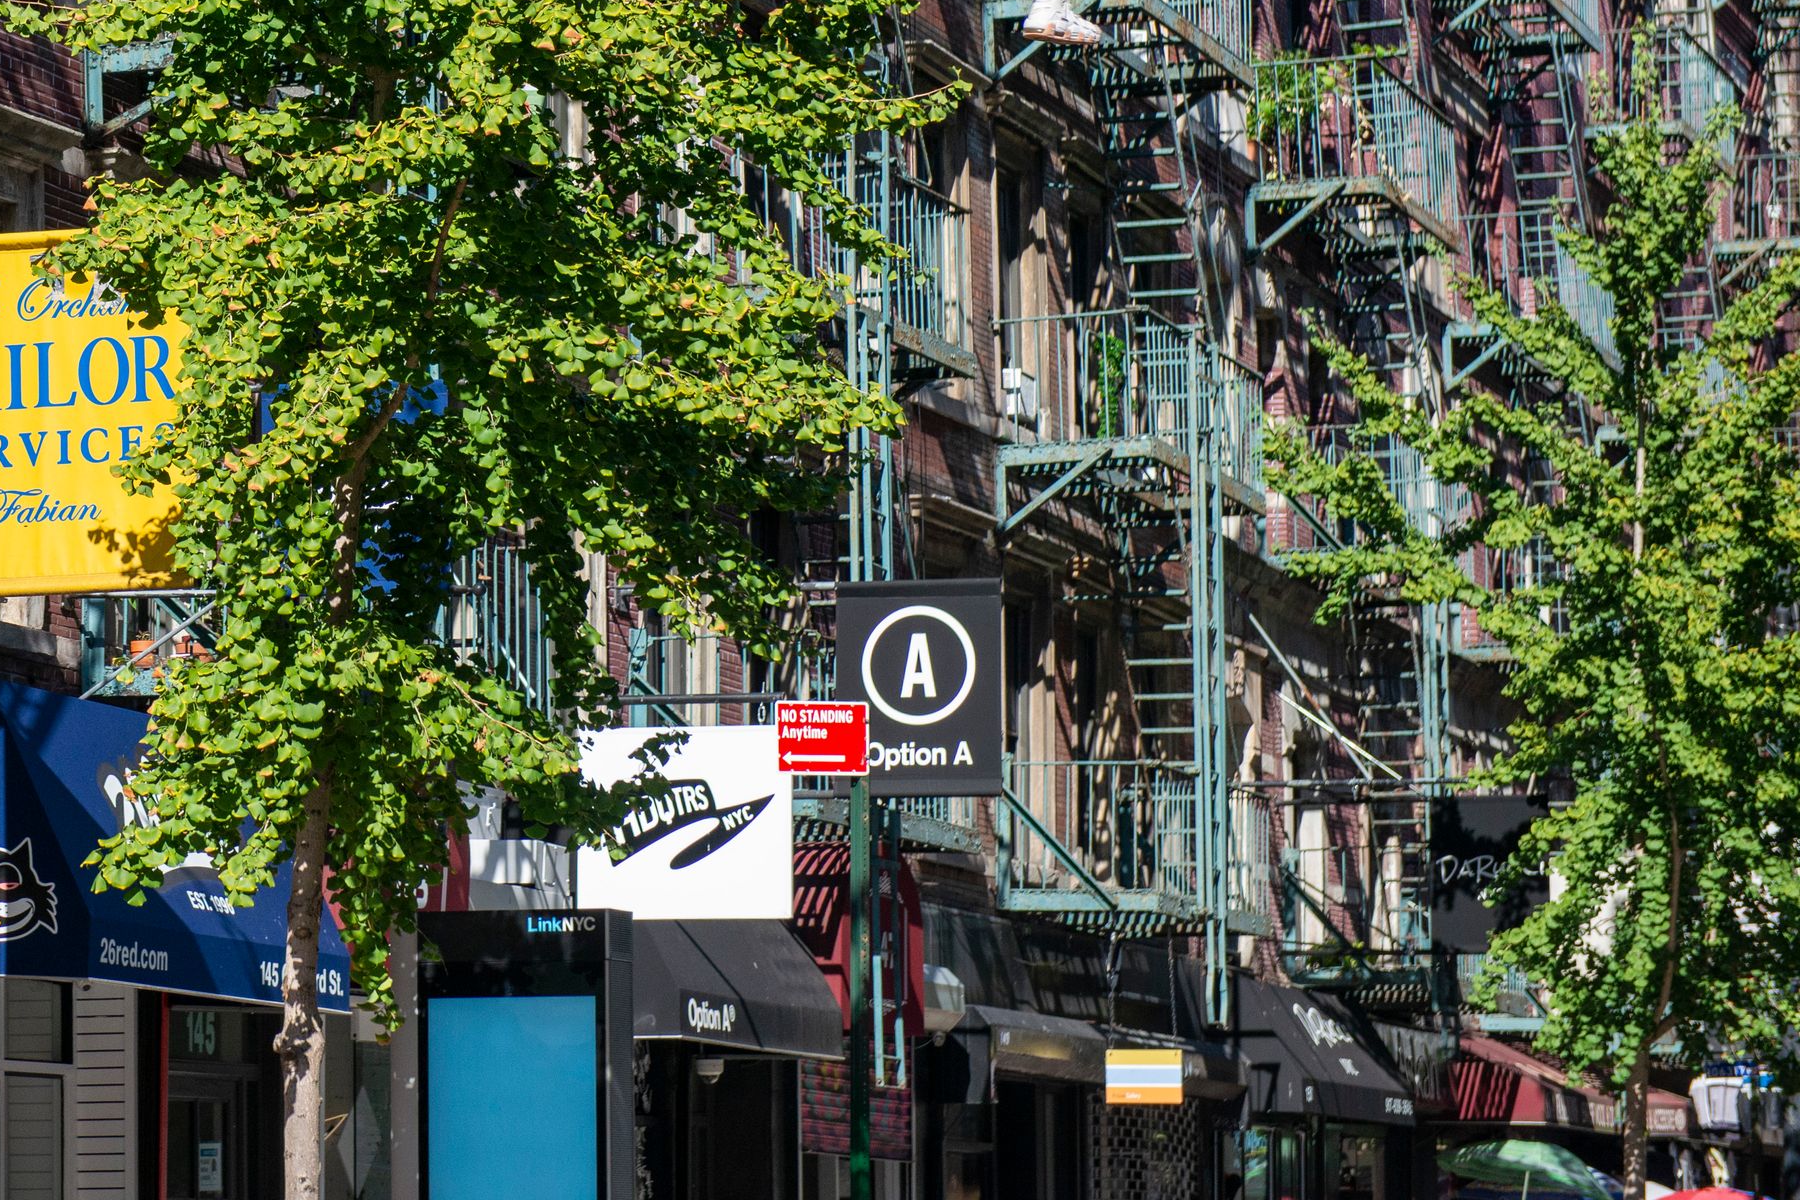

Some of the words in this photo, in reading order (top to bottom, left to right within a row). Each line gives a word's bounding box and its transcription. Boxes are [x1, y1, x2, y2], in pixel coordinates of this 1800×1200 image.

[17, 277, 147, 322] Orcha
[900, 632, 937, 699] A
[781, 709, 797, 723] NO
[799, 709, 854, 724] STANDING
[781, 725, 828, 740] Anytime
[868, 741, 947, 771] Option
[953, 740, 974, 766] A
[722, 805, 754, 831] NYC
[186, 890, 213, 911] EST.
[213, 895, 235, 916] 1996
[527, 916, 596, 933] LinkNYC
[100, 936, 168, 971] 26red.com
[260, 960, 279, 987] 145
[328, 972, 344, 996] St.
[688, 998, 721, 1033] Option
[186, 1011, 216, 1055] 145
